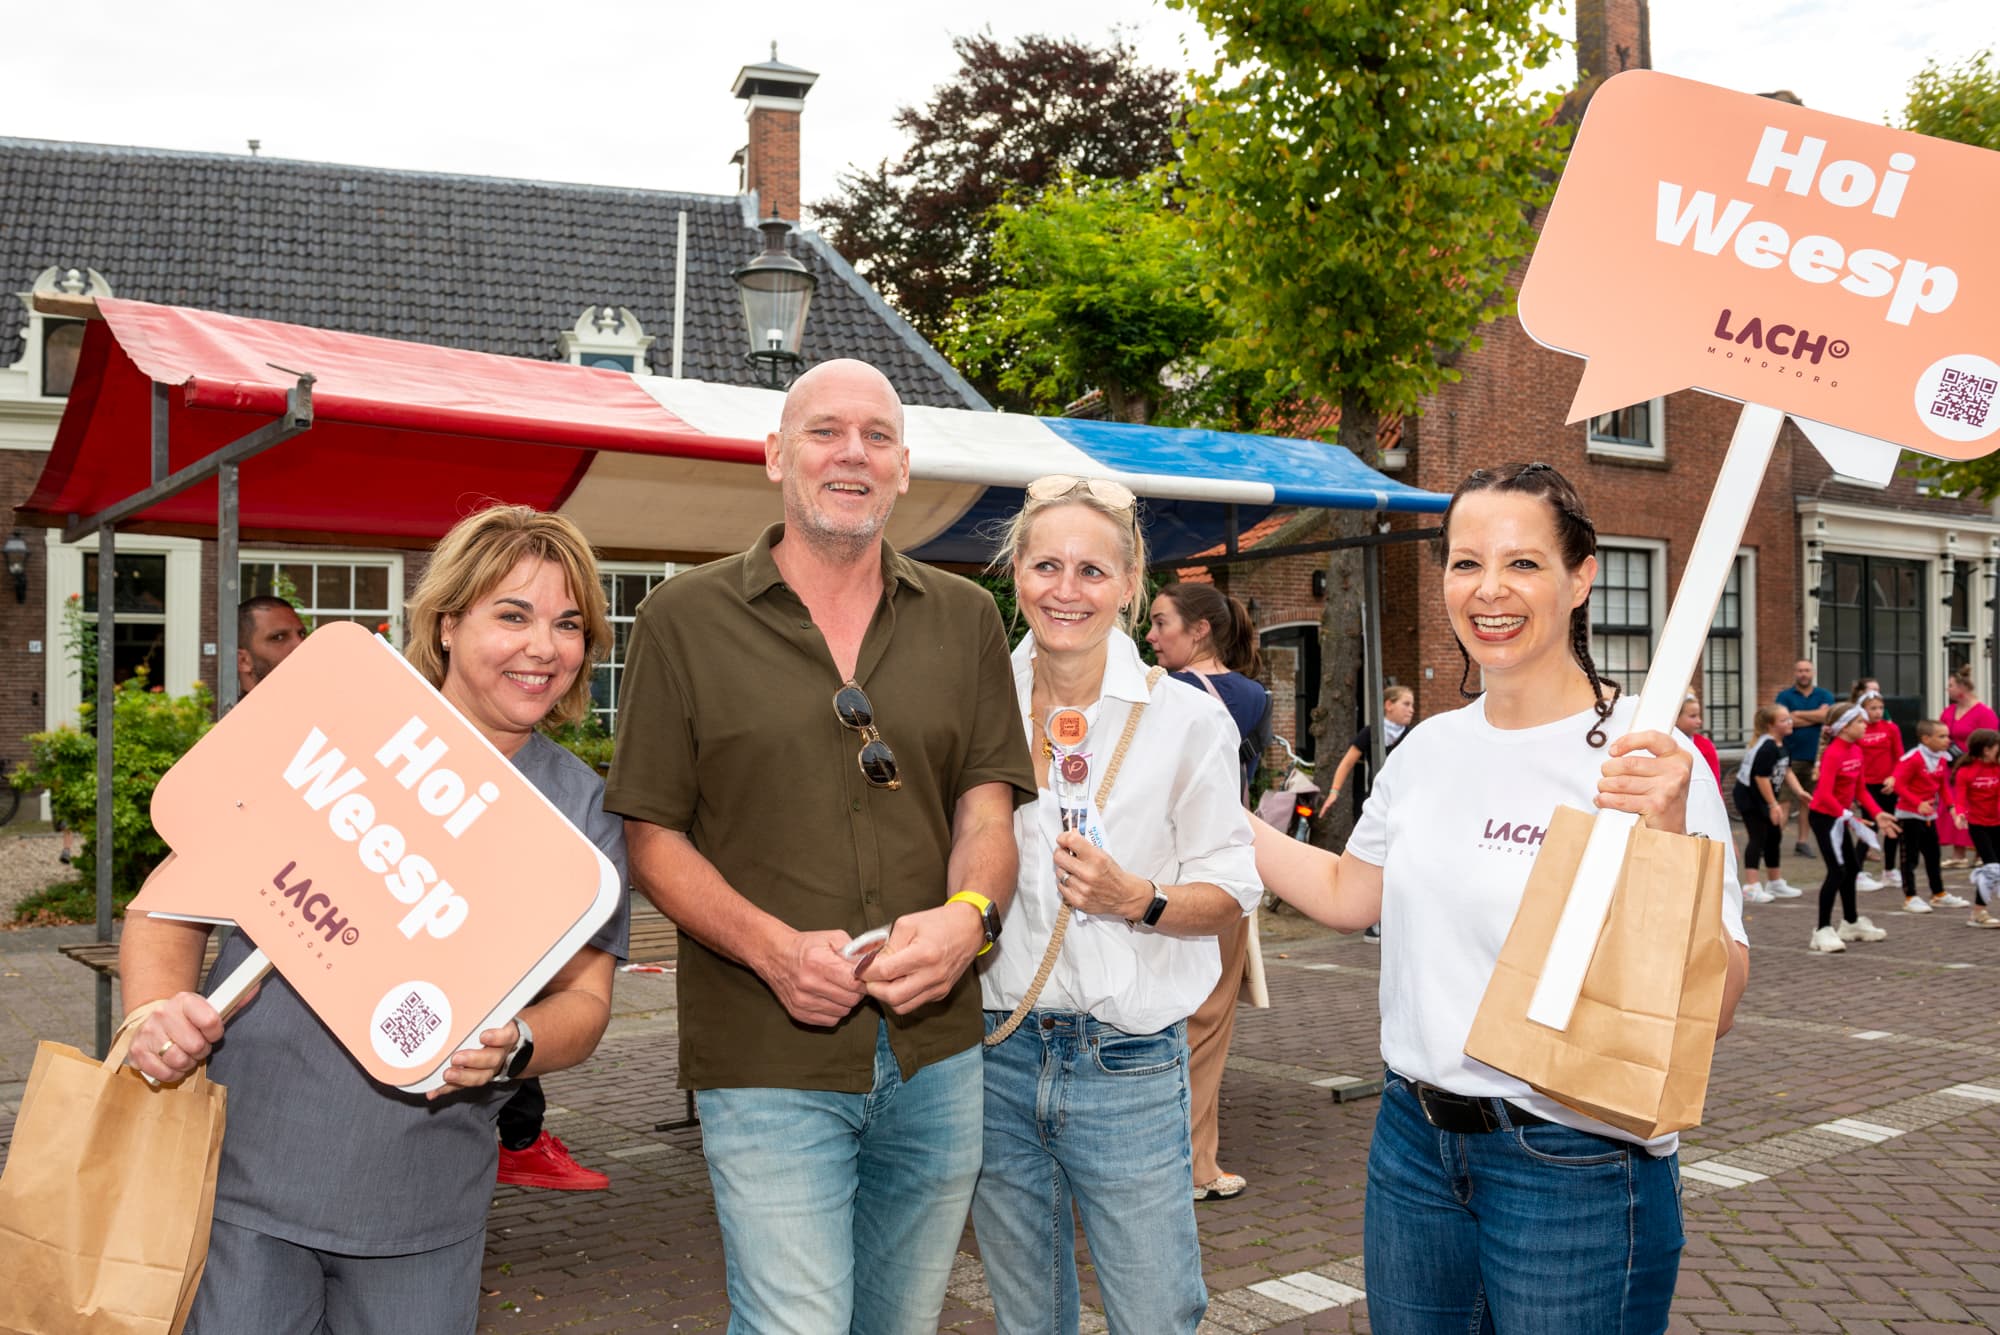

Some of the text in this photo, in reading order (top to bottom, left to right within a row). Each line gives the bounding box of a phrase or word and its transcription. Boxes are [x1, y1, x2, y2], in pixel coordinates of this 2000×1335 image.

[1746, 125, 1916, 218] Hoi
[1655, 180, 1959, 326] Weesp
[1706, 346, 1839, 389] MONDZORG
[373, 714, 501, 840] Hoi
[282, 725, 470, 941] Weesp
[259, 888, 333, 971] MONDZORG
